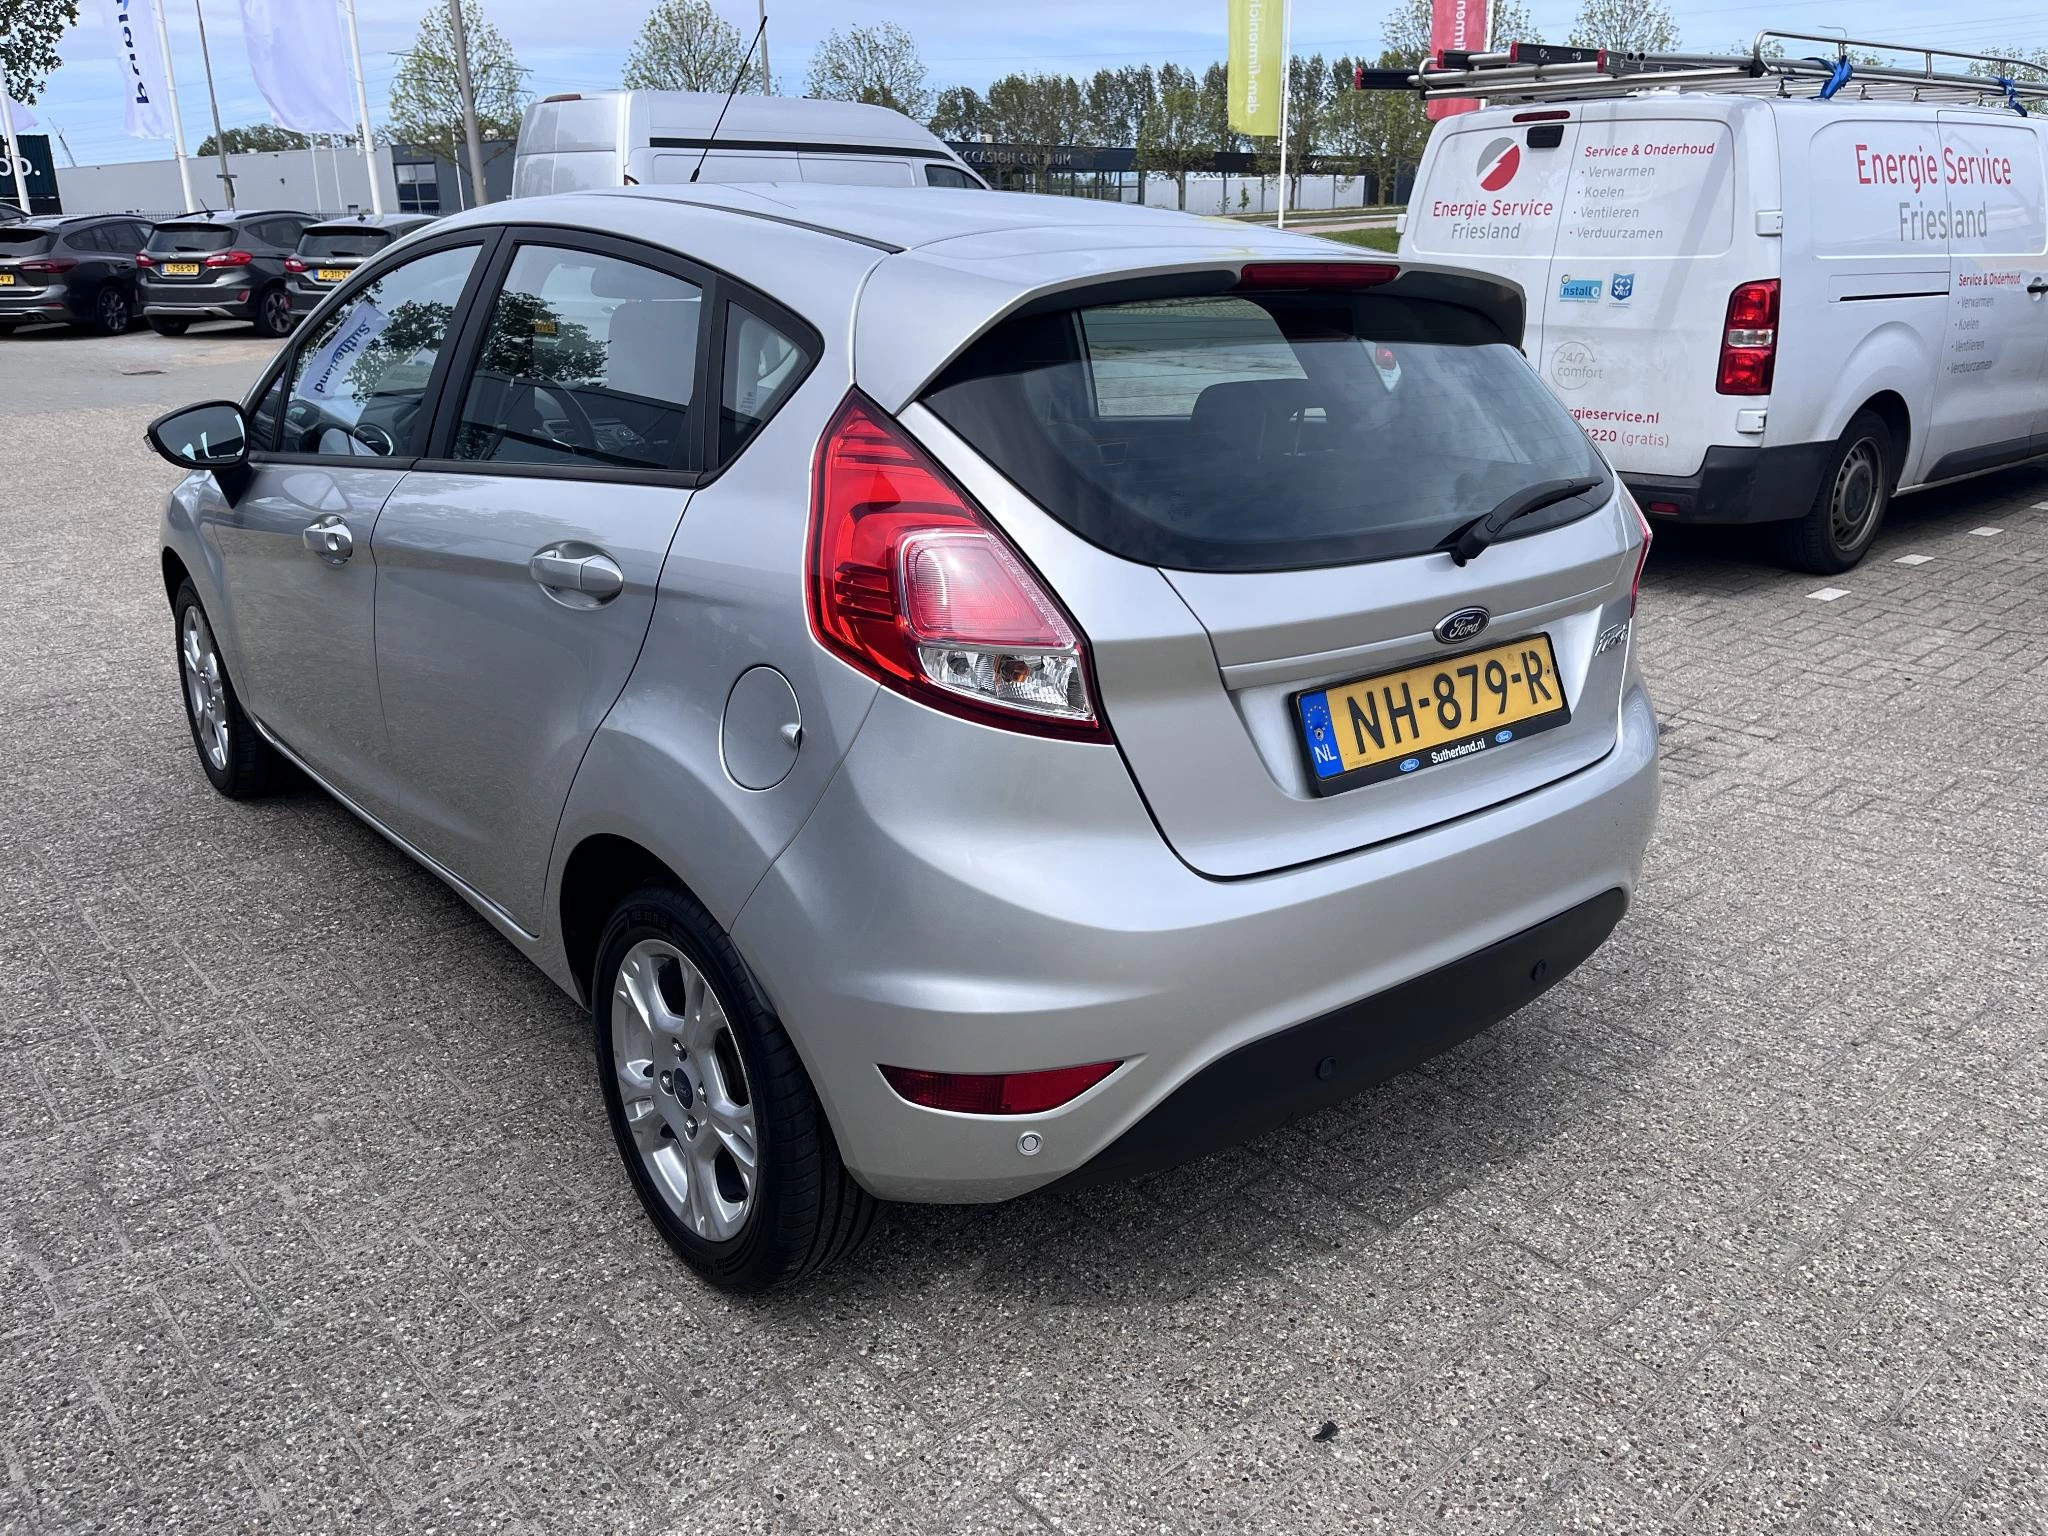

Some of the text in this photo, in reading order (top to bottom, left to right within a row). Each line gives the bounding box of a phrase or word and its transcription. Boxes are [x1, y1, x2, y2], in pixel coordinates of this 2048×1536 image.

[1585, 143, 1715, 157] Service & Onderhoud
[1588, 166, 1655, 177] Verwarmen
[1855, 144, 2012, 194] Energie Service
[1584, 187, 1624, 198] Koelen
[1433, 199, 1553, 220] Energie Service
[1580, 206, 1639, 218] Ventileren
[1899, 200, 1987, 241] Friesland
[1451, 222, 1521, 239] Friesland
[1577, 228, 1663, 239] Verduurzamen
[1959, 273, 1982, 286] Service
[314, 322, 371, 394] Sutherland
[1559, 352, 1585, 363] 24/7
[1557, 366, 1603, 379] comfort
[1585, 428, 1669, 448] 220 (gratis)
[1449, 615, 1481, 638] Ford
[1347, 651, 1552, 754] NH-879-R
[1314, 744, 1337, 764] NL
[1431, 738, 1486, 764] Sutherland.nl
